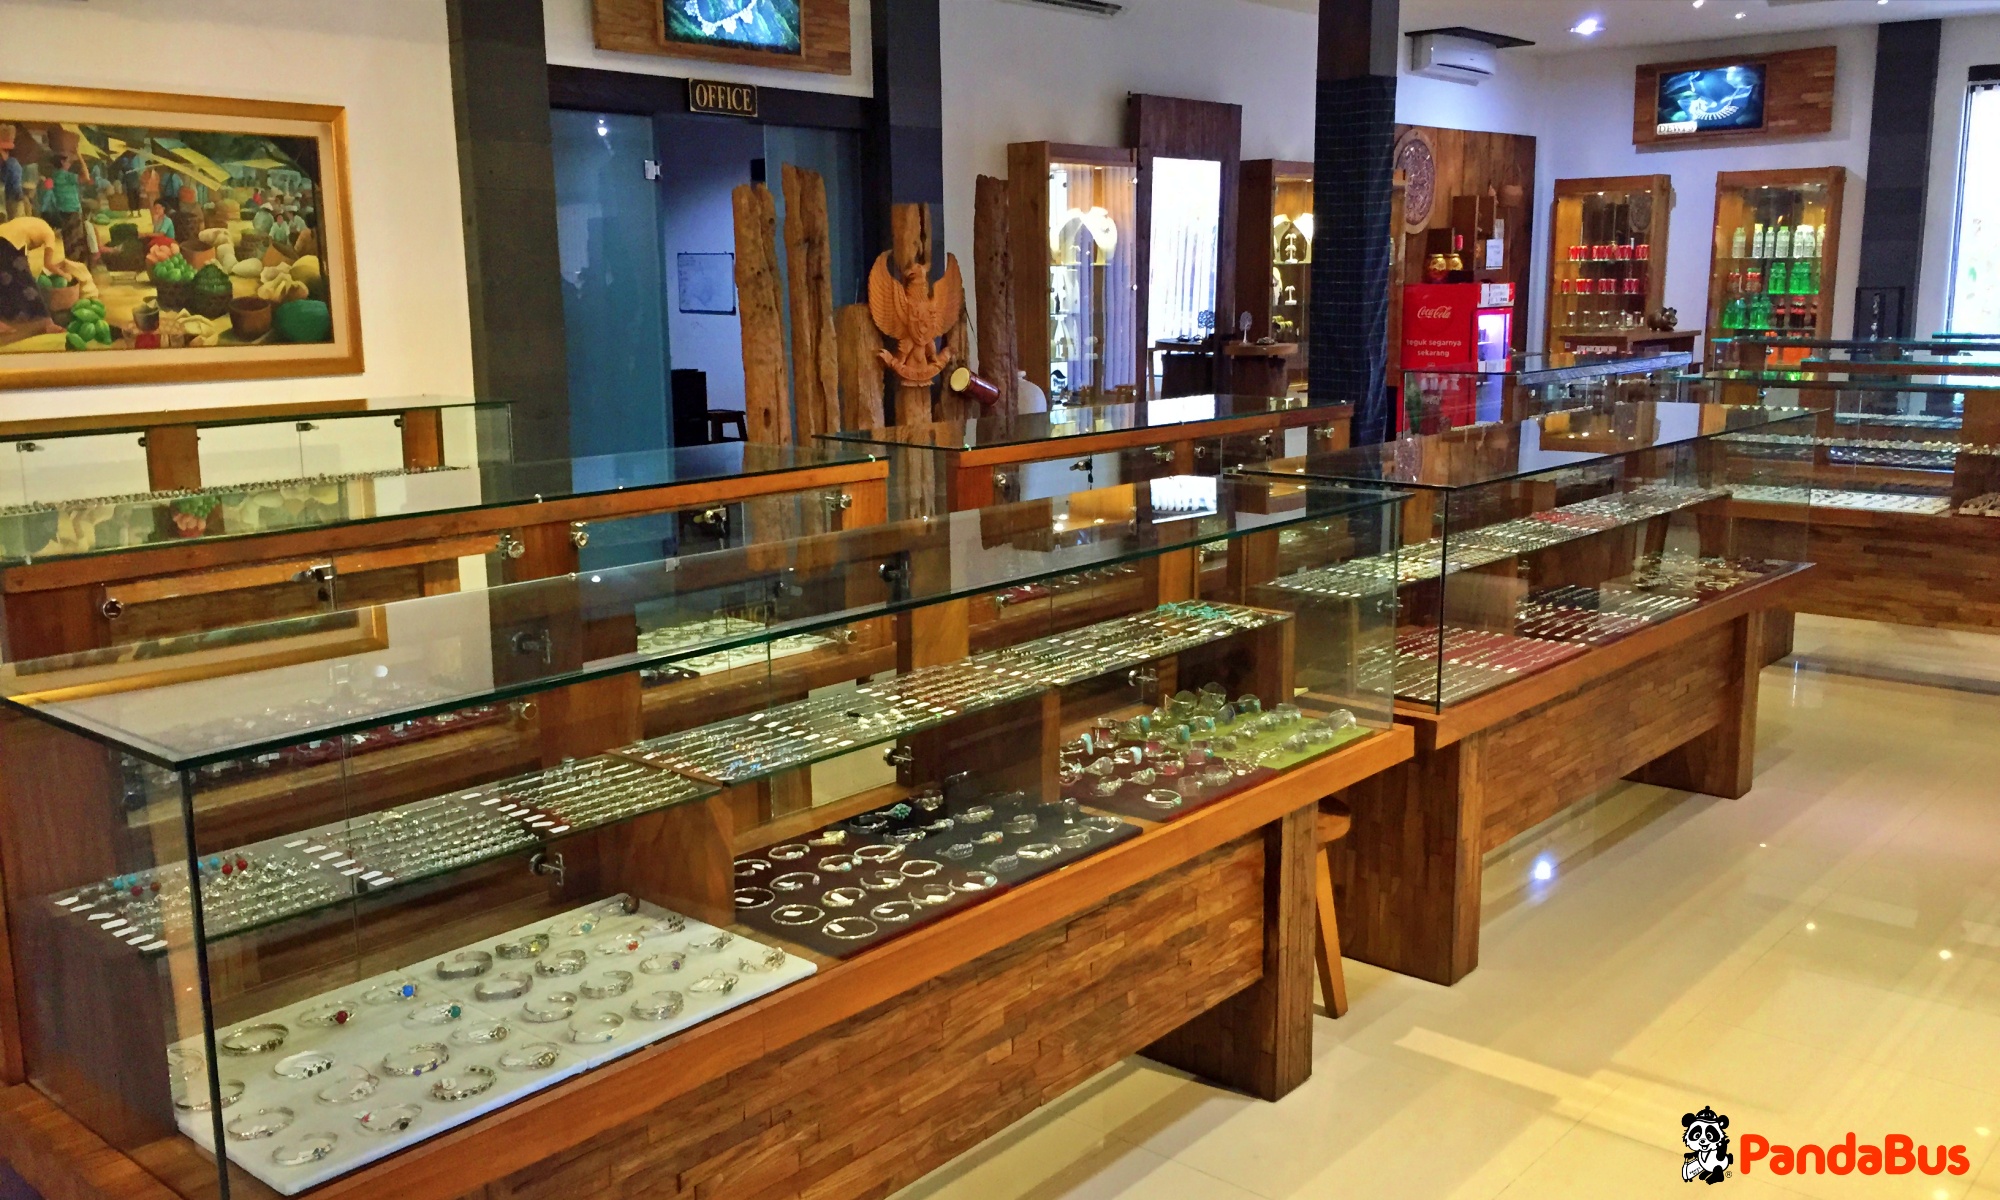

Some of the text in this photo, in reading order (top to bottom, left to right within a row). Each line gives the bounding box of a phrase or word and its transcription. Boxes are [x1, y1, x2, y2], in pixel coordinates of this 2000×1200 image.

[695, 83, 753, 112] OFFICE
[1406, 339, 1462, 348] teguk segarnya
[1417, 349, 1450, 358] sekarang
